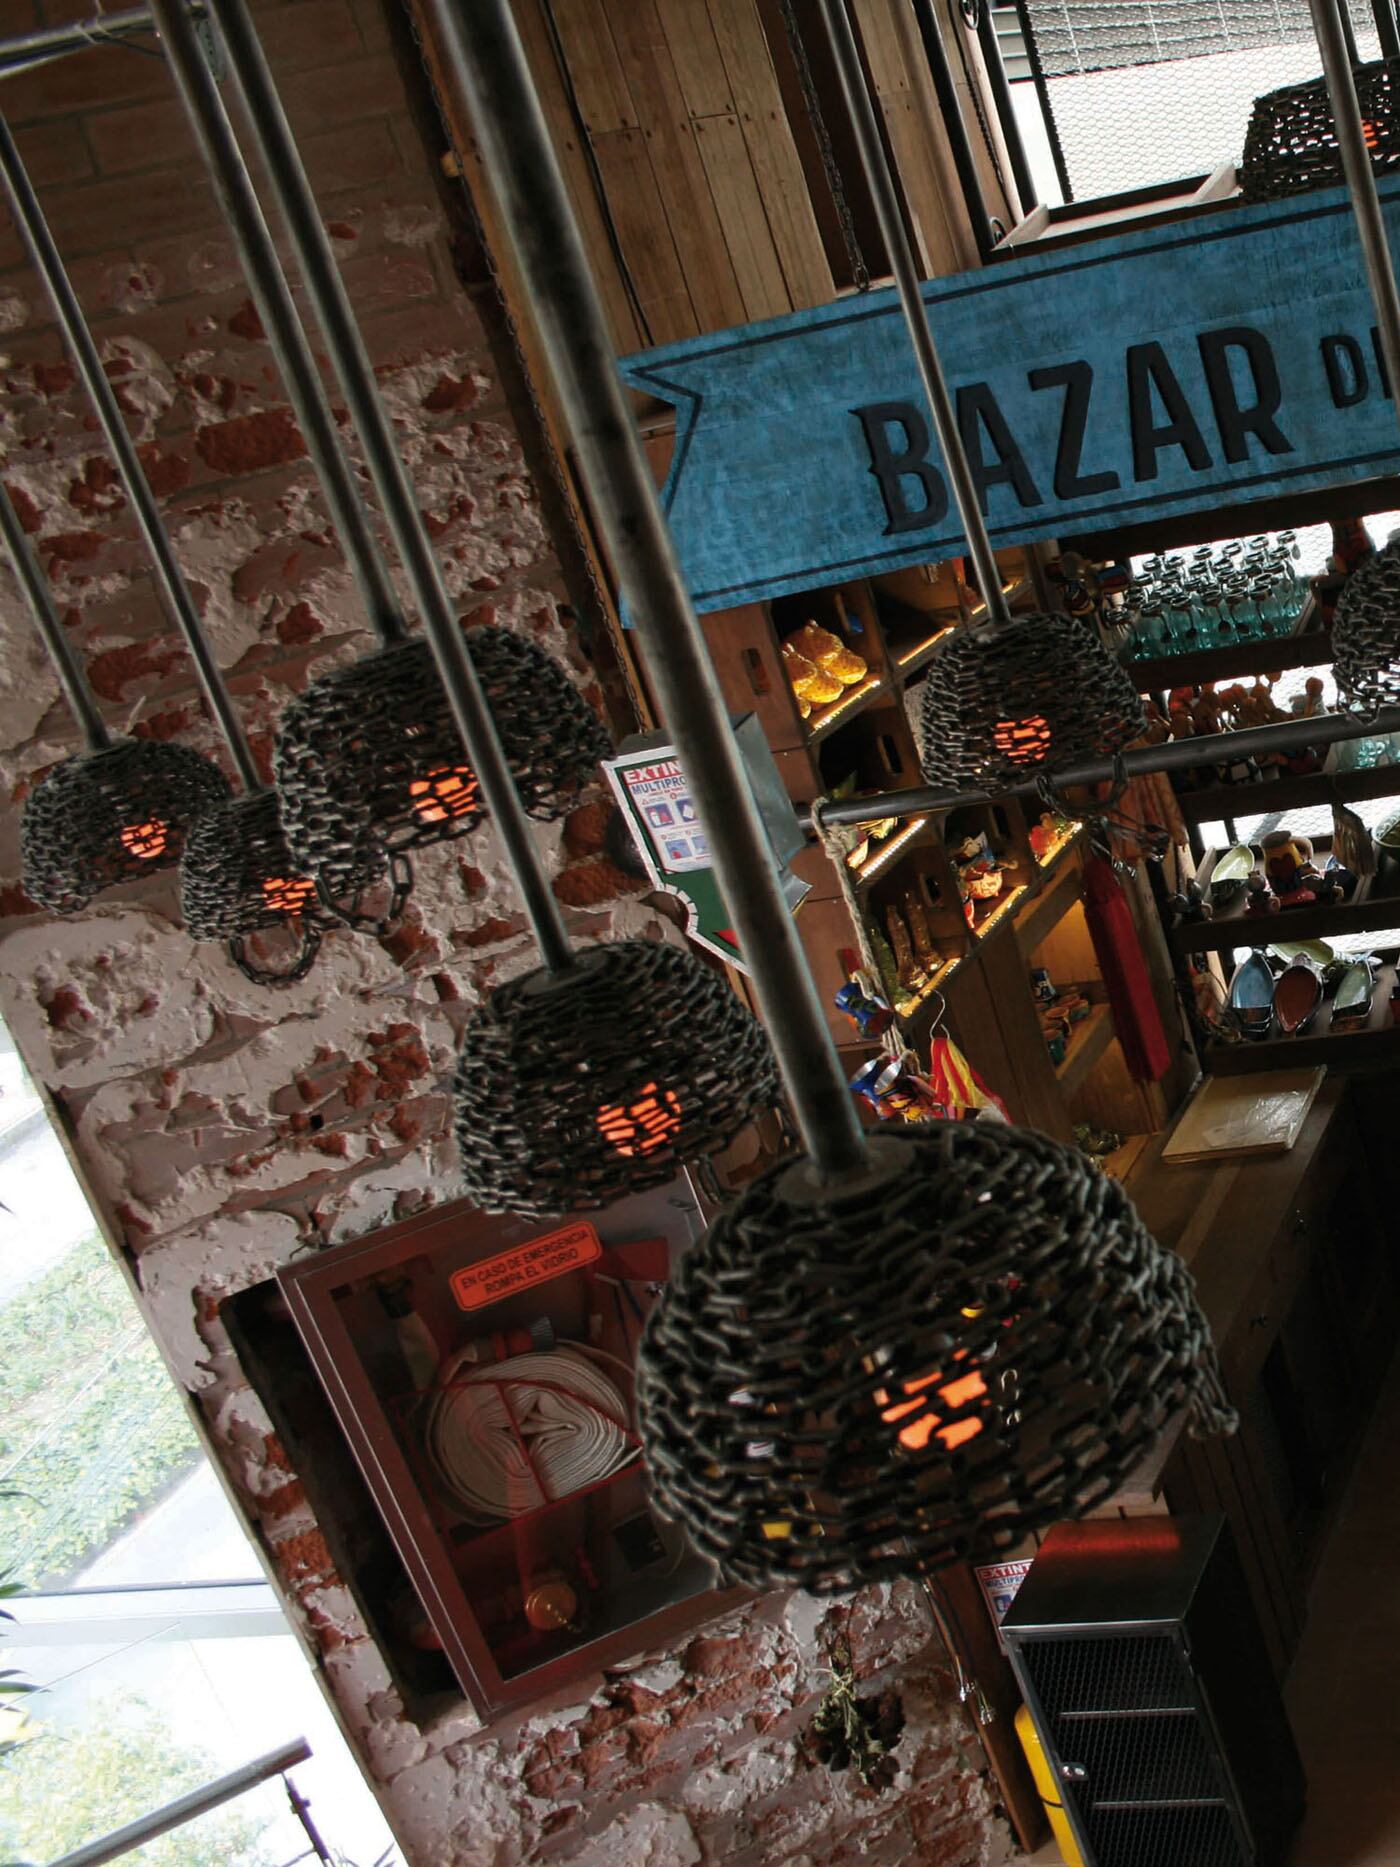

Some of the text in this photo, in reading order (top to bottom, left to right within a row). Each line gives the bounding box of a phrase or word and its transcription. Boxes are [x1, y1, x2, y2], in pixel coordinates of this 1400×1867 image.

[849, 329, 1295, 536] BAZAR
[461, 1230, 588, 1289] EN CASO DE EMERGENCIA
